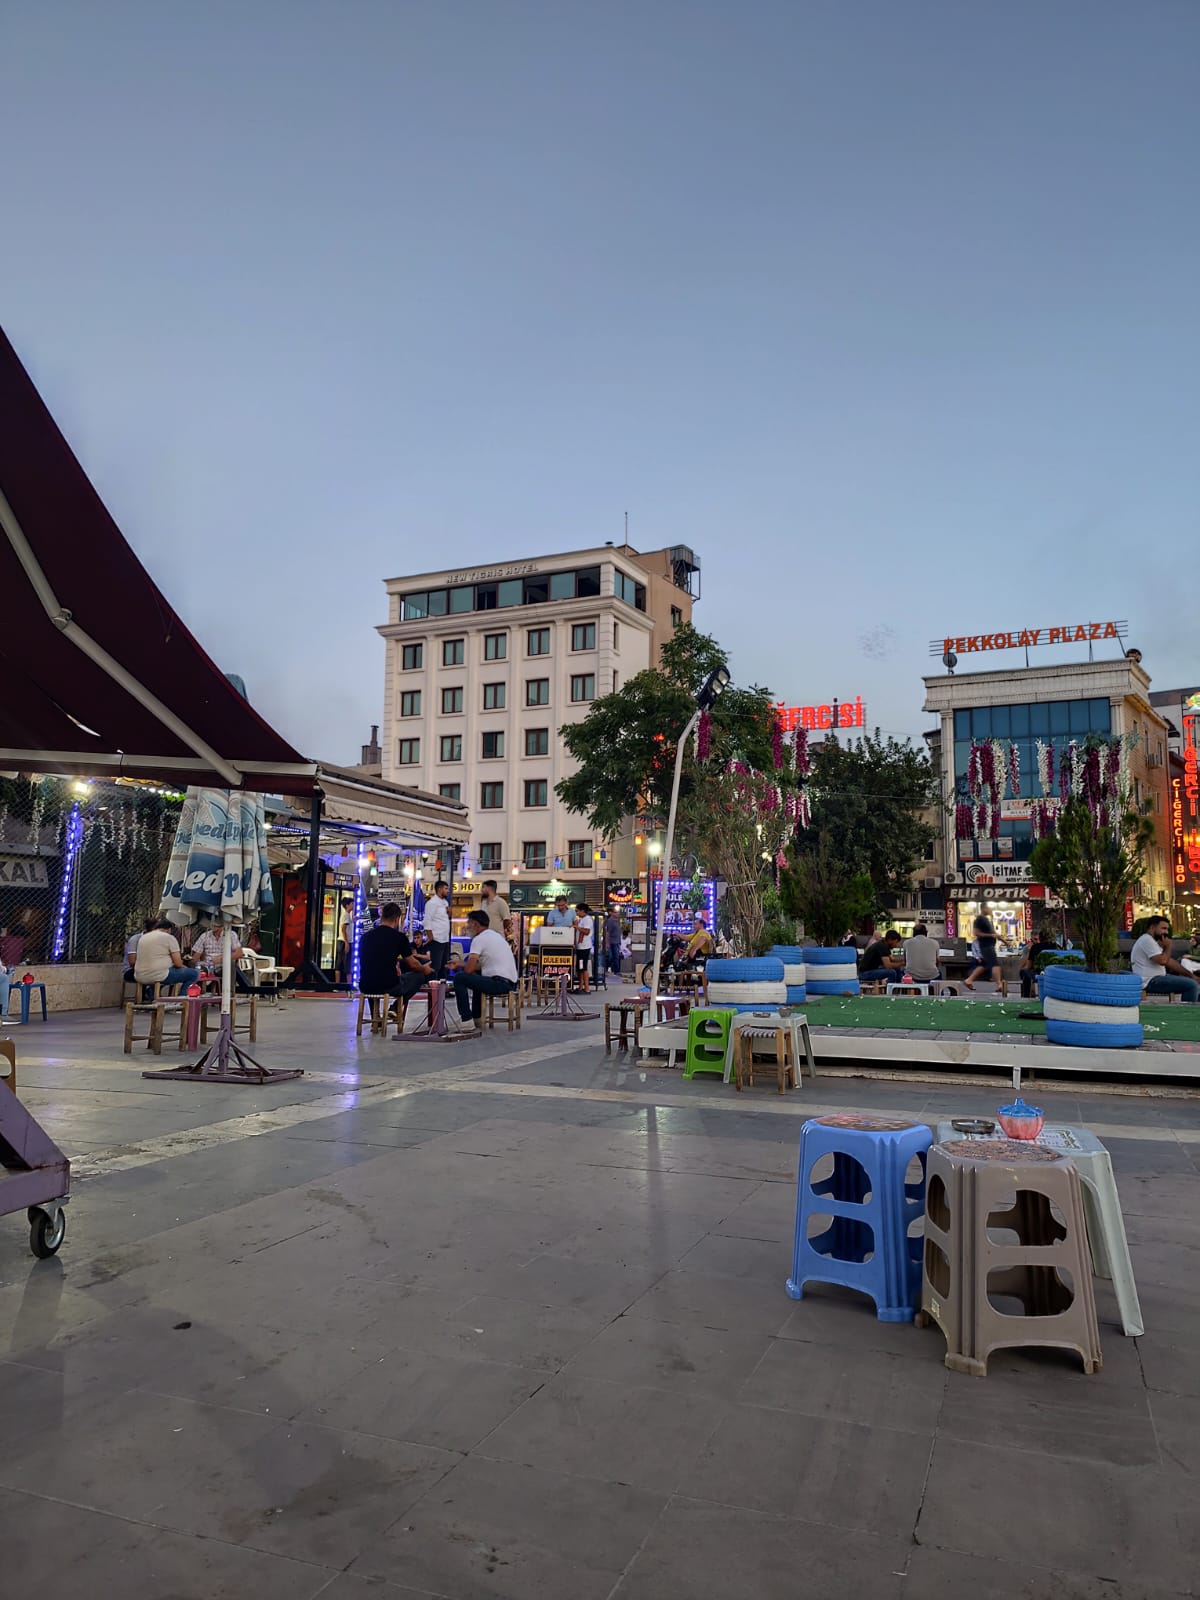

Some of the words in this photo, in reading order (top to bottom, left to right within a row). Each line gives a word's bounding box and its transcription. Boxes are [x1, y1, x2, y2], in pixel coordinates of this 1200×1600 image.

[447, 573, 466, 584] NEW
[469, 568, 503, 581] TIGRIS
[504, 563, 538, 576] HOTEL
[944, 630, 1040, 655] PEKKOLAY
[1049, 622, 1117, 644] PLAZA
[976, 874, 994, 884] alfa
[949, 888, 979, 898] ELİF
[983, 887, 1029, 898] OPTİK
